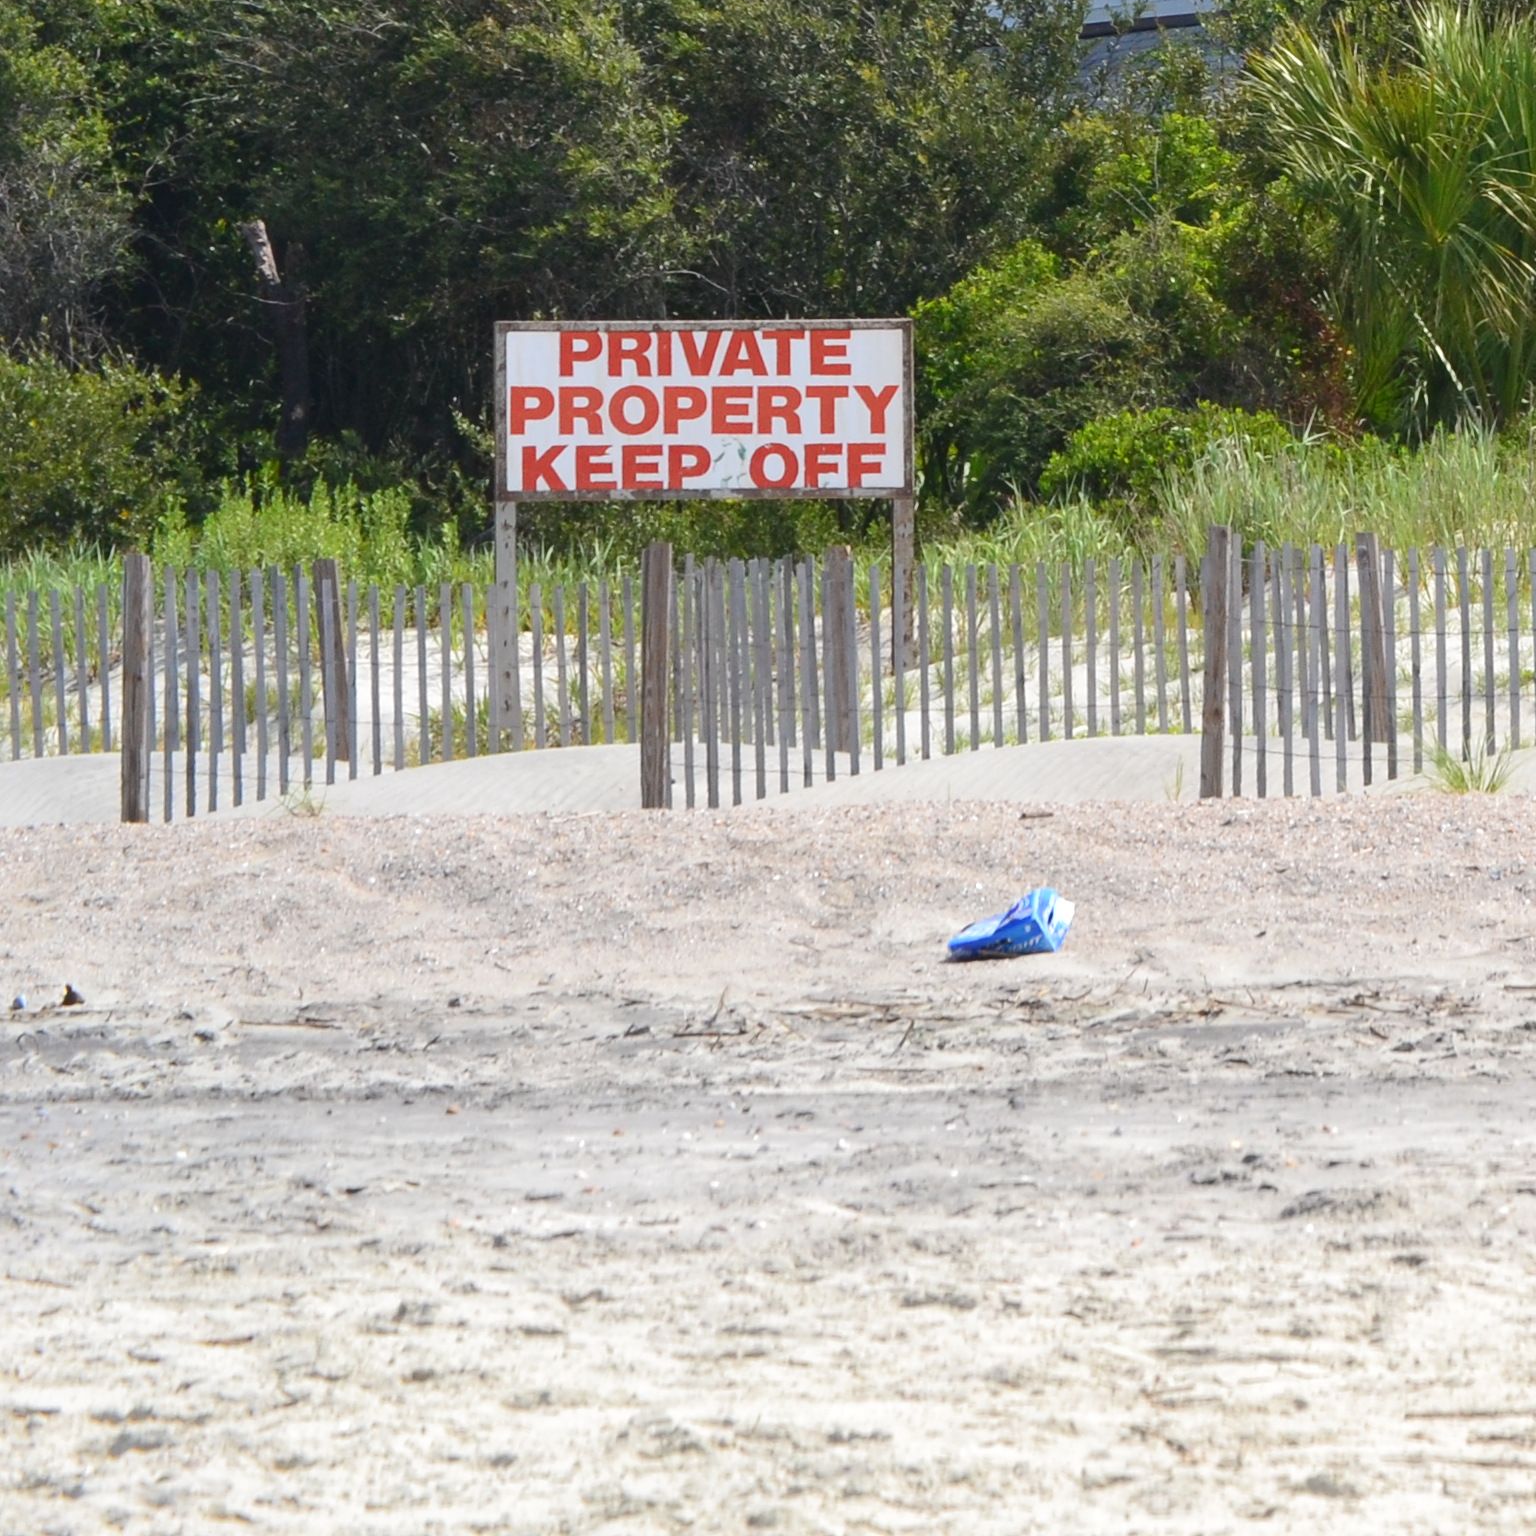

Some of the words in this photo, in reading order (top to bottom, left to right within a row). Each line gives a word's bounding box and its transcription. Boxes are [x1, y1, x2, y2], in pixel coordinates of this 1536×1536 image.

[558, 329, 852, 377] PRIVATE
[509, 385, 899, 436] PROPERTY
[520, 444, 712, 492] KEEP
[748, 442, 887, 489] OFF
